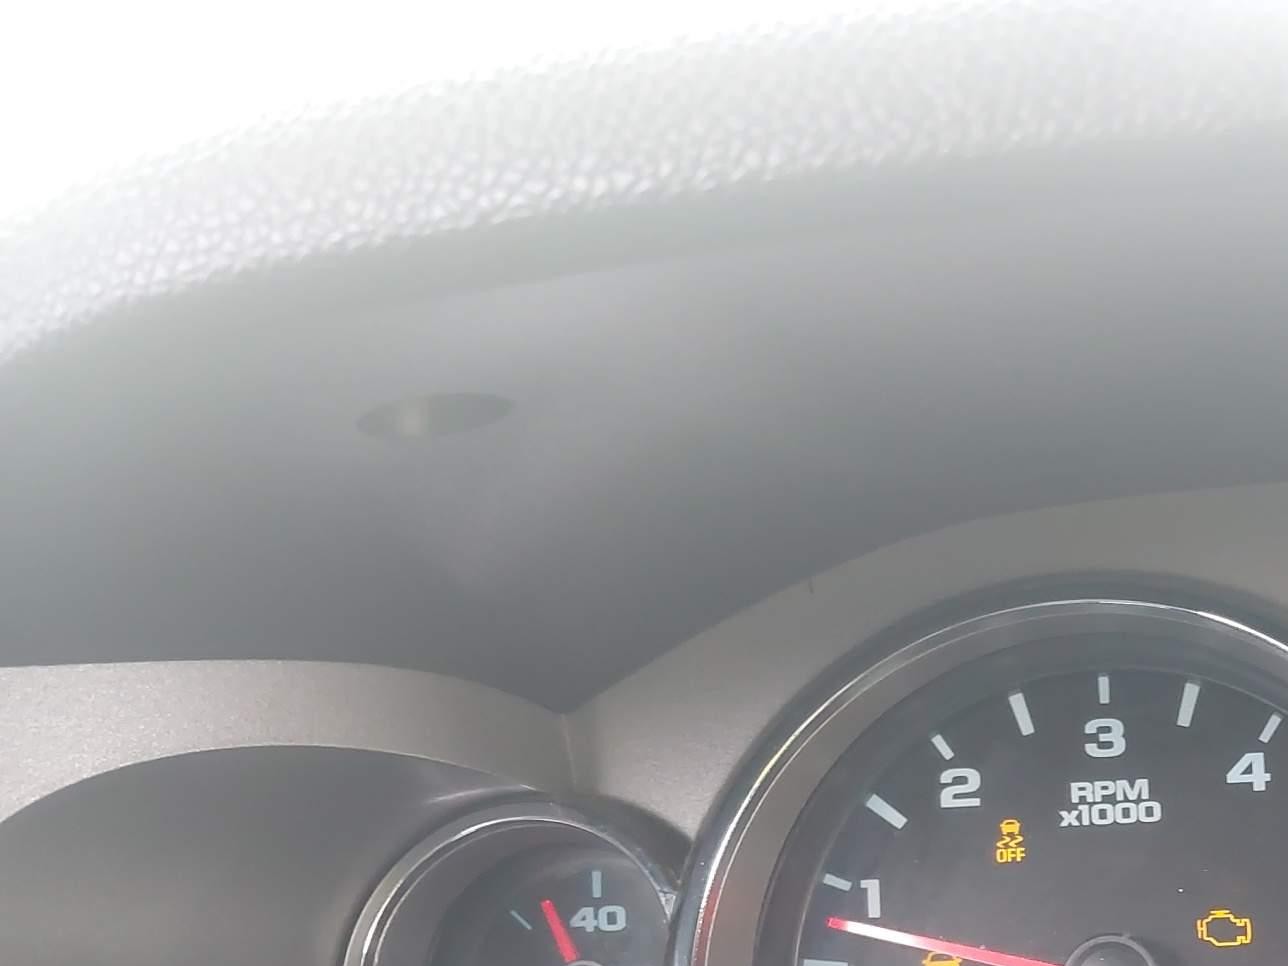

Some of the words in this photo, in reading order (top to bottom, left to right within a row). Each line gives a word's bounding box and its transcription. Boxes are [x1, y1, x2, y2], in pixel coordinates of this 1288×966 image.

[1084, 718, 1126, 758] 3
[939, 768, 981, 809] 2
[1225, 752, 1272, 792] 4
[1070, 778, 1150, 804] RPM
[1058, 801, 1162, 828] x1000
[995, 848, 1026, 863] OFF
[860, 879, 881, 918] 1
[569, 905, 627, 932] 40
